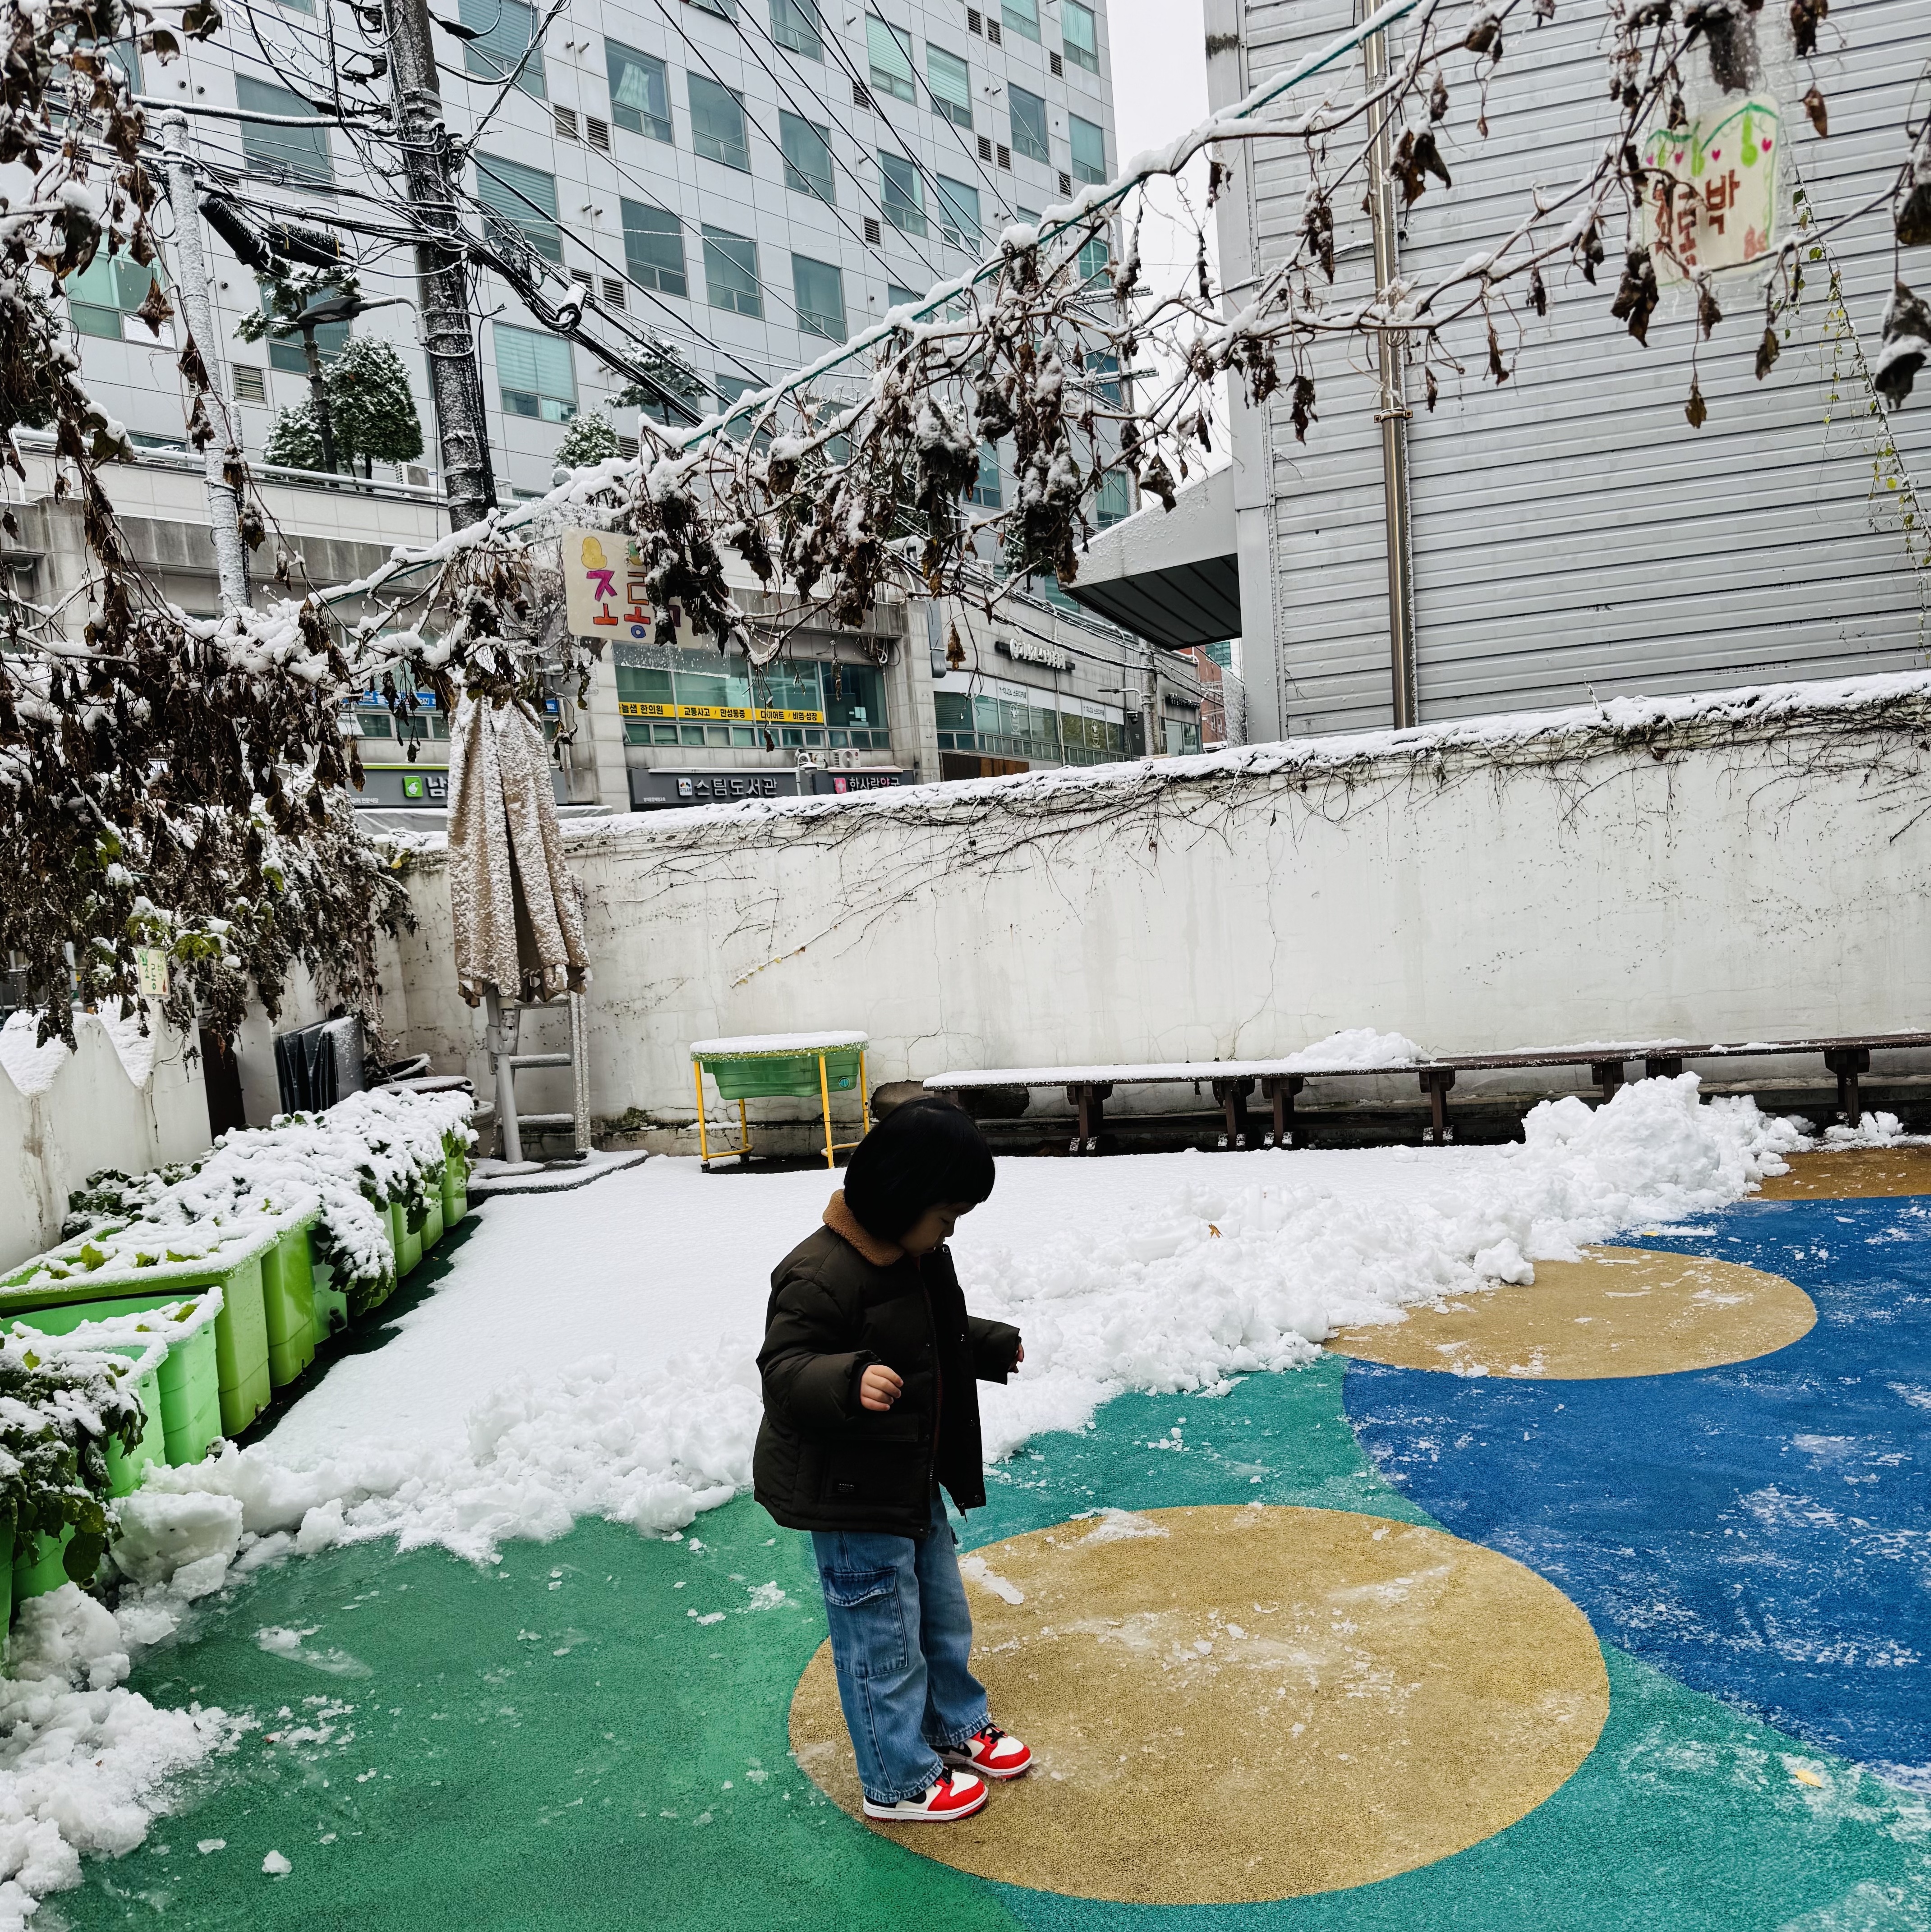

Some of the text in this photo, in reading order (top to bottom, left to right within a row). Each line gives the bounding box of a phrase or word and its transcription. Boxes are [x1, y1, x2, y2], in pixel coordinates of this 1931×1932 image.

[586, 569, 682, 639] 조롱
[619, 703, 638, 714] 늘샘
[640, 704, 664, 715] 한의원
[684, 707, 711, 716] 교통사고
[720, 708, 745, 718] 만성통증
[760, 710, 784, 720] 다이어트
[694, 777, 777, 796] 스팀도서관
